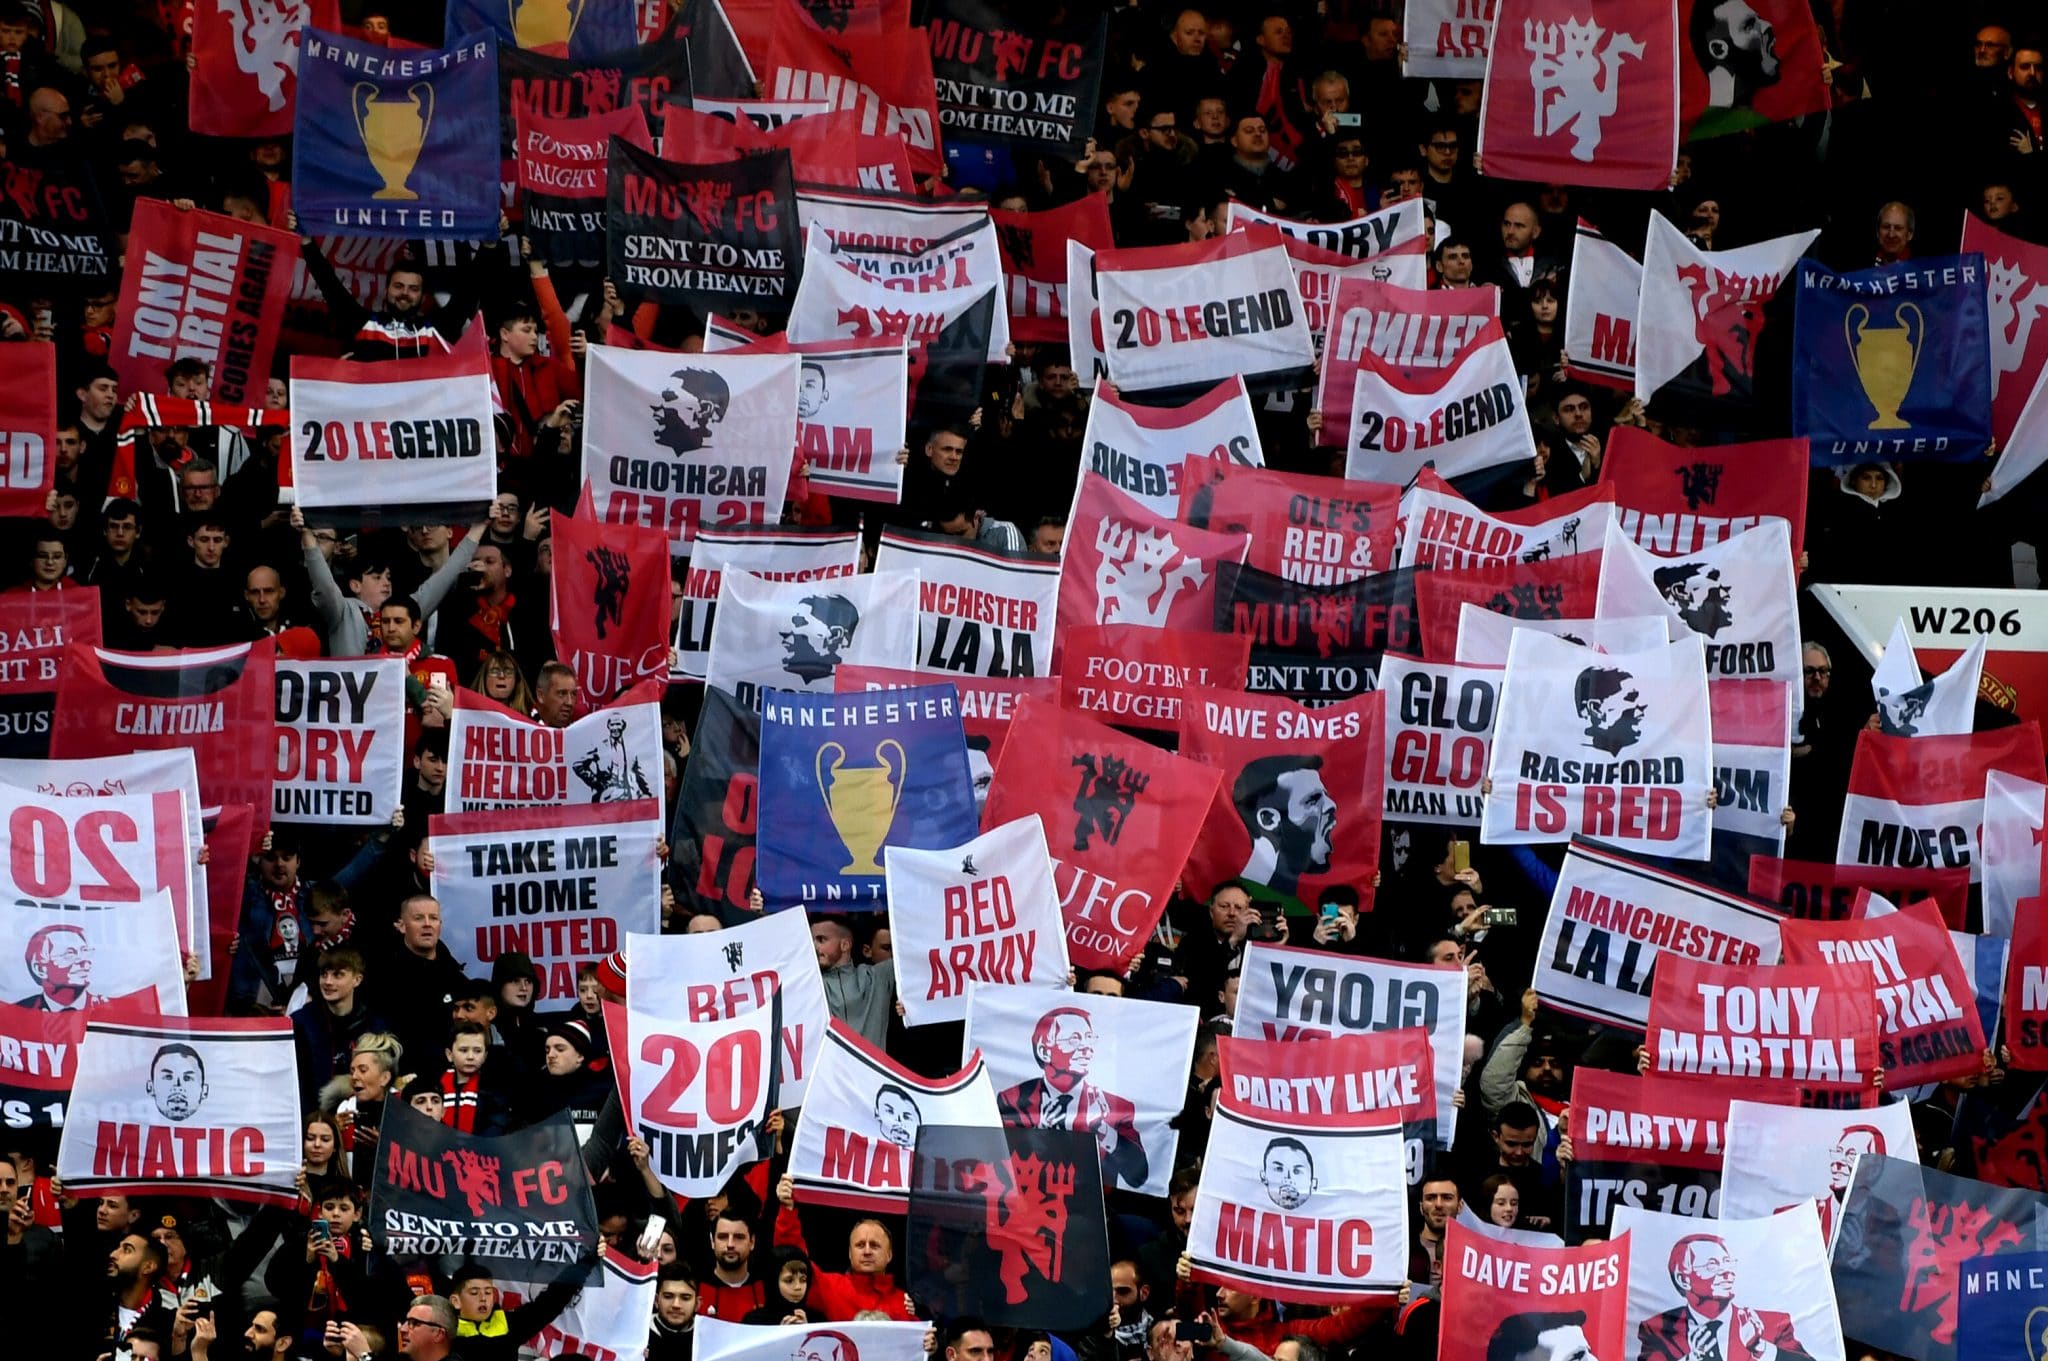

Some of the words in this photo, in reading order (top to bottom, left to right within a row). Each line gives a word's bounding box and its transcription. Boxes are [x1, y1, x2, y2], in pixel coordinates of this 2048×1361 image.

[307, 38, 488, 78] MANCHESTER
[927, 17, 982, 65] MU
[1036, 40, 1083, 81] FC
[510, 77, 570, 121] MU
[629, 75, 672, 118] FC
[936, 77, 984, 109] ENT
[988, 89, 1028, 117] TO
[1033, 90, 1076, 120] ME
[526, 130, 610, 163] FOOTBA
[982, 112, 1074, 143] HEAVEN
[527, 159, 597, 189] TAUGHT
[44, 184, 89, 222] FC
[335, 206, 455, 229] UNITED
[529, 212, 577, 232] MATT
[623, 174, 685, 221] MU
[735, 190, 779, 233] FC
[27, 222, 62, 252] TO
[65, 231, 104, 258] ME
[624, 235, 697, 264] SENT
[700, 242, 739, 271] TO
[741, 246, 786, 275] ME
[26, 250, 110, 278] HEAVEN
[625, 264, 691, 291] FROM
[691, 269, 786, 297] HEAVEN
[1804, 266, 1977, 297] MANCHESTER
[128, 249, 189, 360] TONY
[219, 321, 259, 405] CORES
[239, 239, 277, 315] AGAIN
[1113, 308, 1161, 349] 20
[1167, 288, 1295, 343] LEGEND
[1360, 410, 1407, 452] 20
[1413, 382, 1515, 451] LEGEND
[303, 420, 348, 462] 20
[353, 418, 482, 461] LEGEND
[1831, 436, 1950, 455] UNITED
[1287, 494, 1372, 533] OLE'S
[1419, 506, 1524, 560] HELLO!
[1283, 527, 1343, 565] RED
[1350, 536, 1373, 568] &
[1281, 559, 1382, 588] WHIT
[920, 581, 1039, 633] NCHESTER
[1233, 602, 1298, 647] MU
[1366, 604, 1412, 648] FC
[1910, 605, 2022, 645] W206
[927, 616, 981, 674] LA
[986, 629, 1036, 680] LA
[1706, 641, 1776, 677] FORD
[573, 644, 668, 698] UFC
[1316, 667, 1358, 693] TO
[115, 702, 225, 736] CANTONA
[275, 670, 379, 725] ORY
[767, 697, 955, 728] MANCHESTER
[1400, 671, 1498, 734] GLO
[1205, 701, 1267, 740] DAVE
[1275, 711, 1361, 741] SAVES
[273, 726, 376, 784] ORY
[464, 725, 565, 764] HELLO!
[1390, 729, 1491, 790] GLO
[460, 765, 568, 801] HELLO!
[1520, 749, 1684, 786] RASHFORD
[276, 787, 374, 817] UNITED
[1385, 788, 1447, 816] MAN
[1514, 783, 1568, 835] IS
[1581, 788, 1683, 842] RED
[466, 839, 559, 879] TAKE
[565, 835, 620, 871] ME
[1857, 819, 1971, 870] MUFC
[492, 876, 599, 918] HOME
[802, 882, 888, 901] UNIT
[945, 876, 1018, 942] RED
[1052, 857, 1153, 936] UFC
[476, 916, 619, 963] UNITED
[1564, 886, 1763, 967] MANCHESTER
[926, 929, 1037, 1001] ARMY
[1551, 918, 1613, 986] LA
[1697, 983, 1821, 1037] TONY
[1657, 1027, 1864, 1084] MARTIAL
[1901, 1027, 1975, 1065] AGAIN
[640, 1028, 762, 1129] 20
[1234, 1073, 1337, 1117] PARTY
[1343, 1062, 1422, 1114] LIKE
[93, 1120, 265, 1178] MATIC
[1585, 1107, 1699, 1153] PARTY
[388, 1142, 446, 1199] MU
[511, 1160, 568, 1208] FC
[384, 1208, 465, 1238] SENT
[470, 1221, 526, 1242] TO
[529, 1220, 581, 1243] ME
[1215, 1201, 1373, 1278] MATIC
[386, 1238, 463, 1258] FROM
[469, 1240, 583, 1265] HEAVEN
[1461, 1245, 1532, 1295] DAVE
[1540, 1253, 1622, 1297] SAVES
